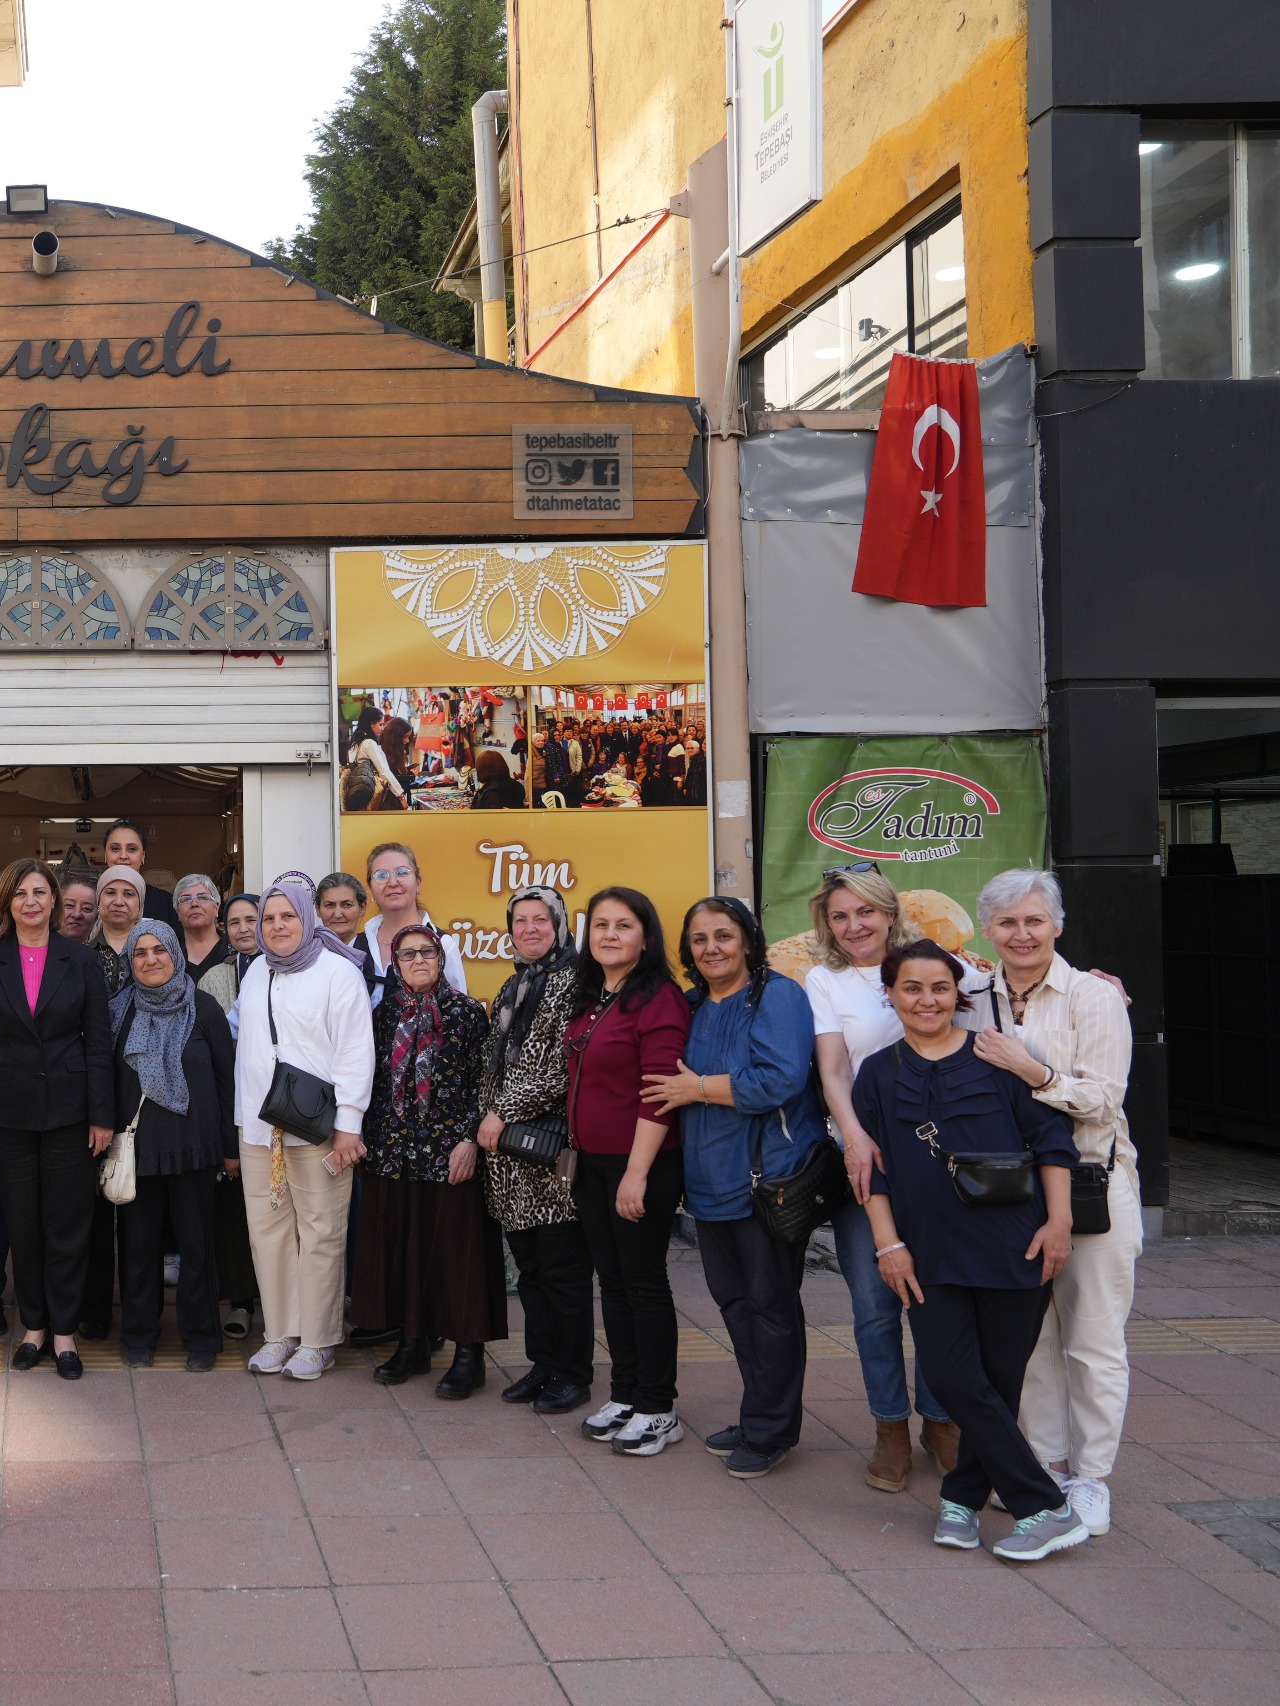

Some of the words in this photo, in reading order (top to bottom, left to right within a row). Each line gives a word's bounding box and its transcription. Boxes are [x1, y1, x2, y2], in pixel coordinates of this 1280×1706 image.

[754, 124, 793, 171] TEPEBAŞI
[525, 432, 619, 451] tepebasibeltr
[526, 495, 621, 511] dtahmetatac
[865, 788, 884, 800] es
[902, 839, 960, 862] tantuni
[479, 842, 575, 893] Tüm
